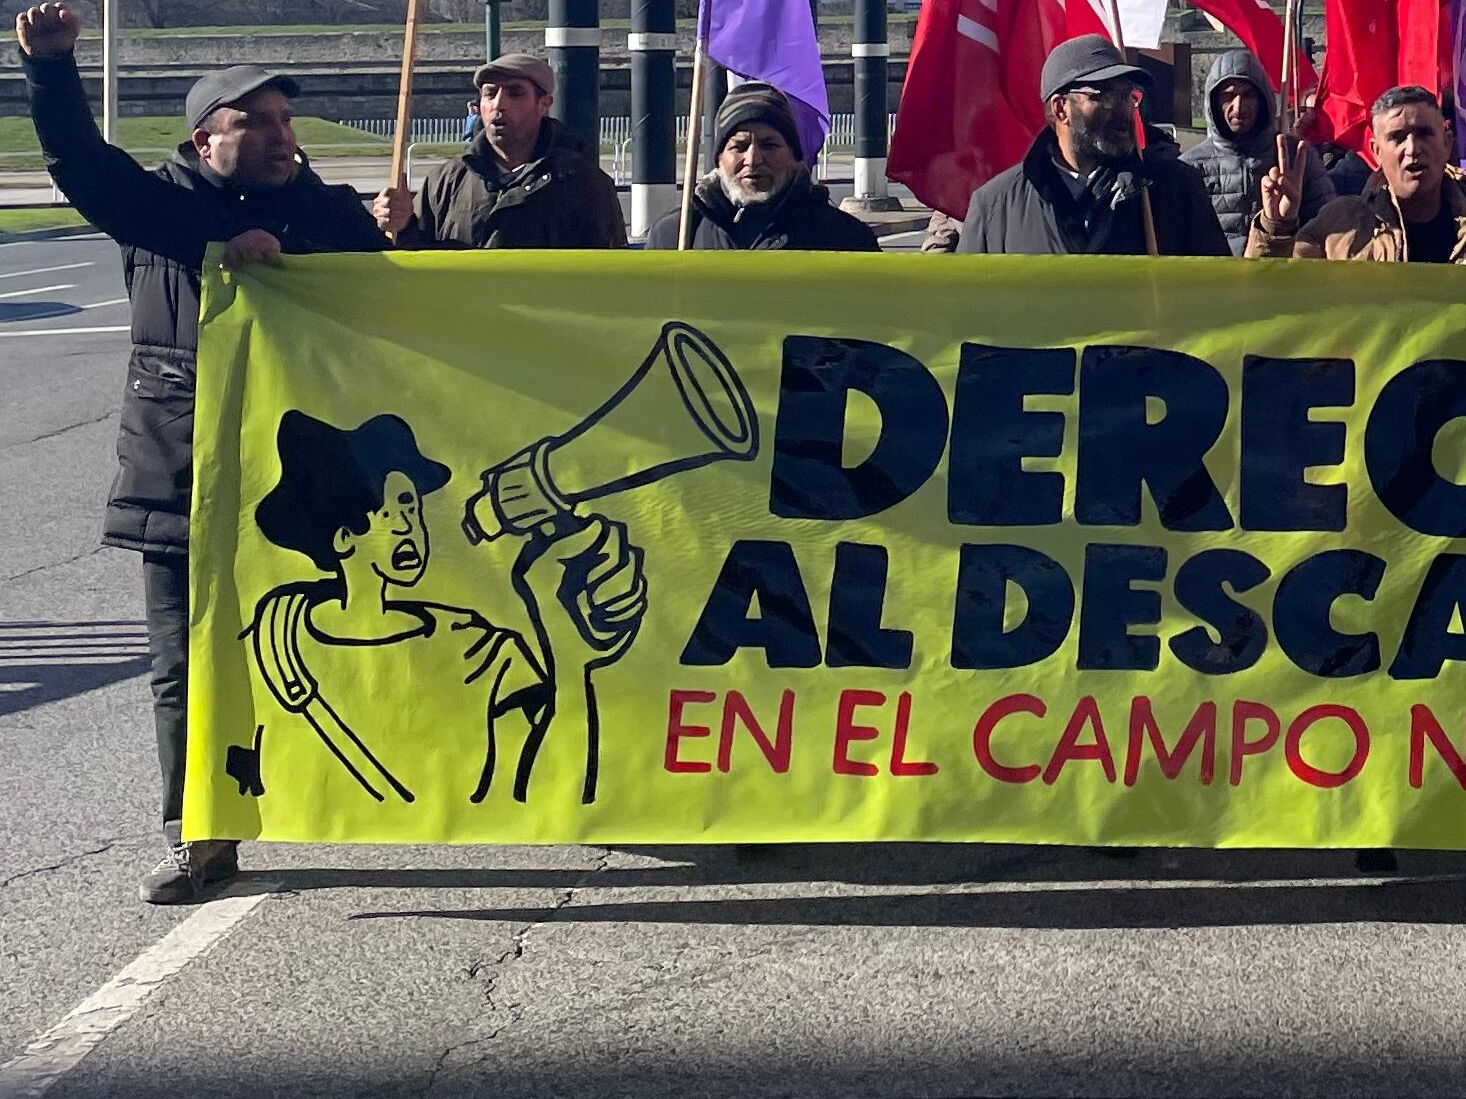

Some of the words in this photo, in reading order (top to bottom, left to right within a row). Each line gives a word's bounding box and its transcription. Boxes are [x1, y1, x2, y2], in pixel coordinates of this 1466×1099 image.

[680, 540, 914, 669] AL
[663, 688, 796, 775] EN
[832, 688, 940, 777] EL
[973, 693, 1370, 788] CAMPO
